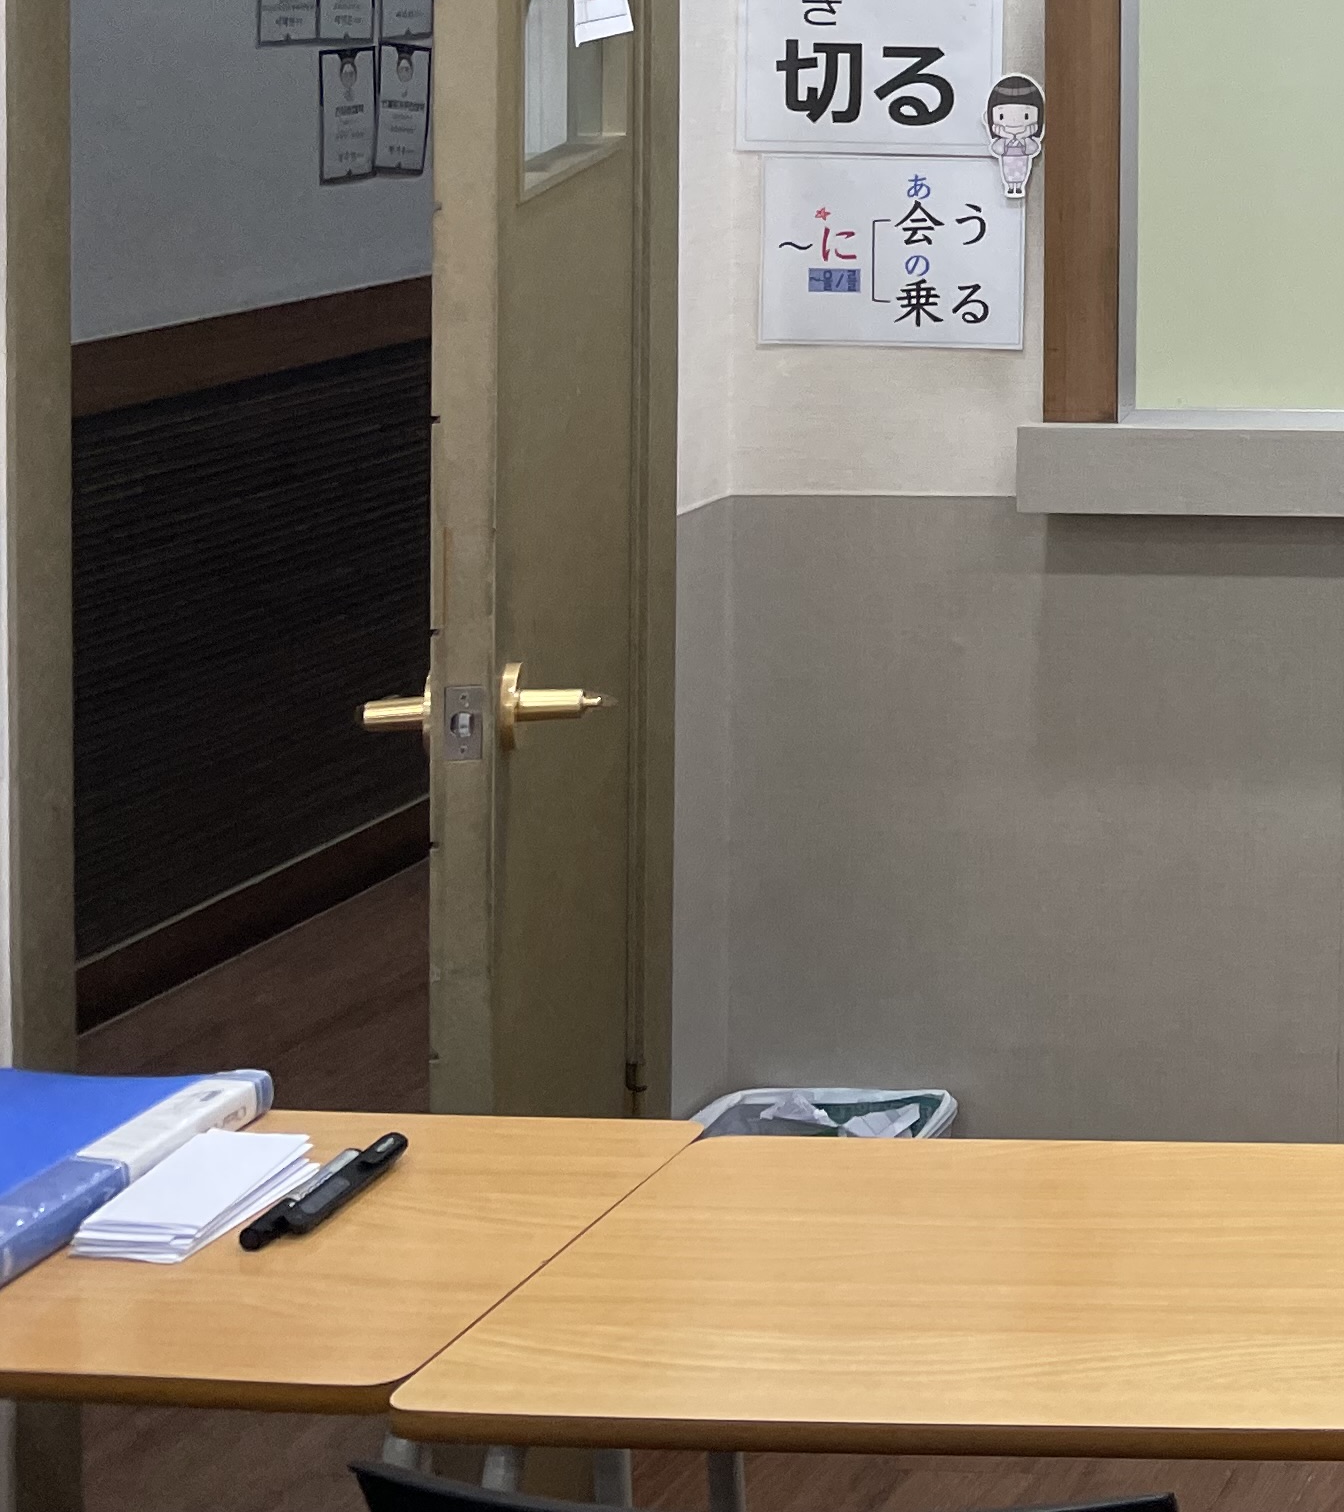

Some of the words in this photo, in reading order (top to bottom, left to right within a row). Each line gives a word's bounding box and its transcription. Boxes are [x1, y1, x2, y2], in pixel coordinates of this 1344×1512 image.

[775, 38, 955, 127] 切る
[906, 173, 931, 200] あ
[894, 199, 988, 246] 会う
[904, 254, 931, 277] の
[894, 278, 990, 329] 乗る
